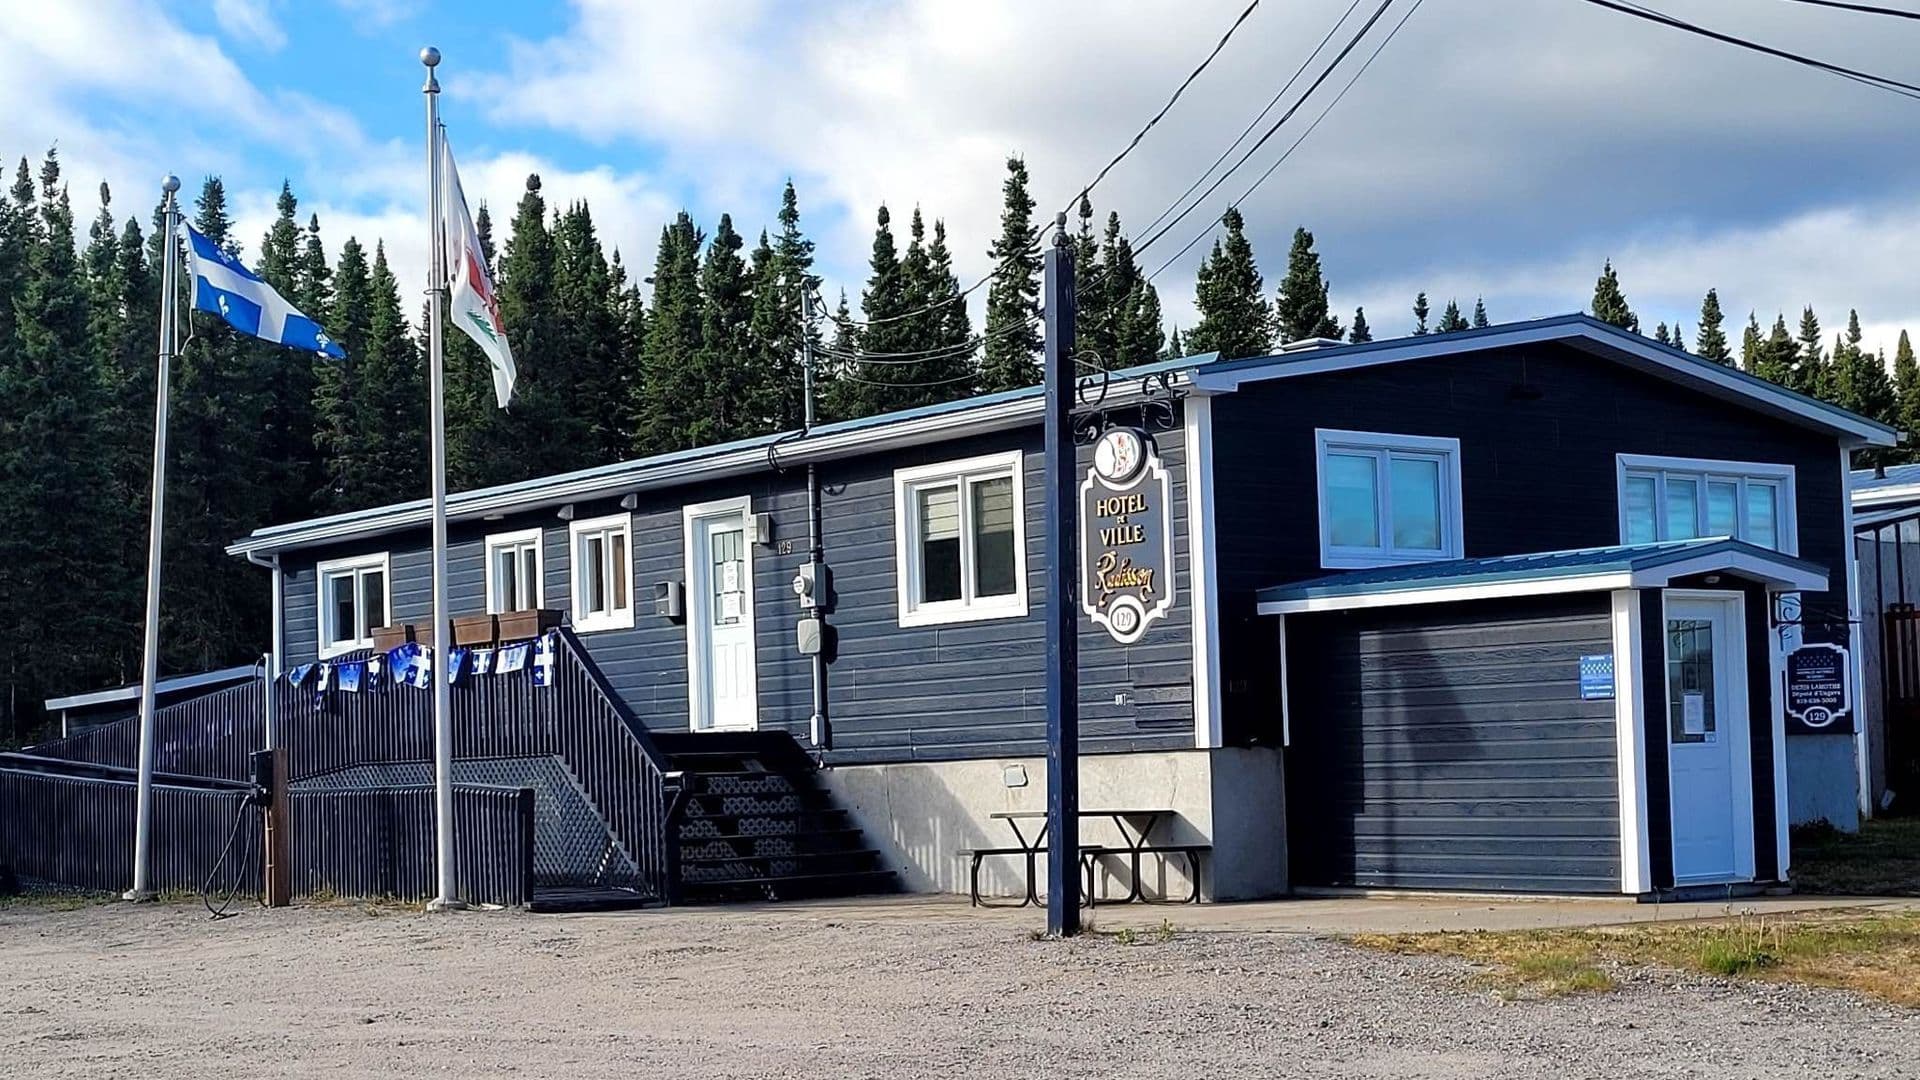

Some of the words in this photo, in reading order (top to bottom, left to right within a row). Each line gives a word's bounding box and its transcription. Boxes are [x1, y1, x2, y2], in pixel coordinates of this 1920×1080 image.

[1096, 494, 1147, 517] HOTEL
[1099, 525, 1144, 546] VILLE
[778, 541, 792, 555] 129
[1115, 612, 1132, 627] 129
[1809, 712, 1826, 721] 129
